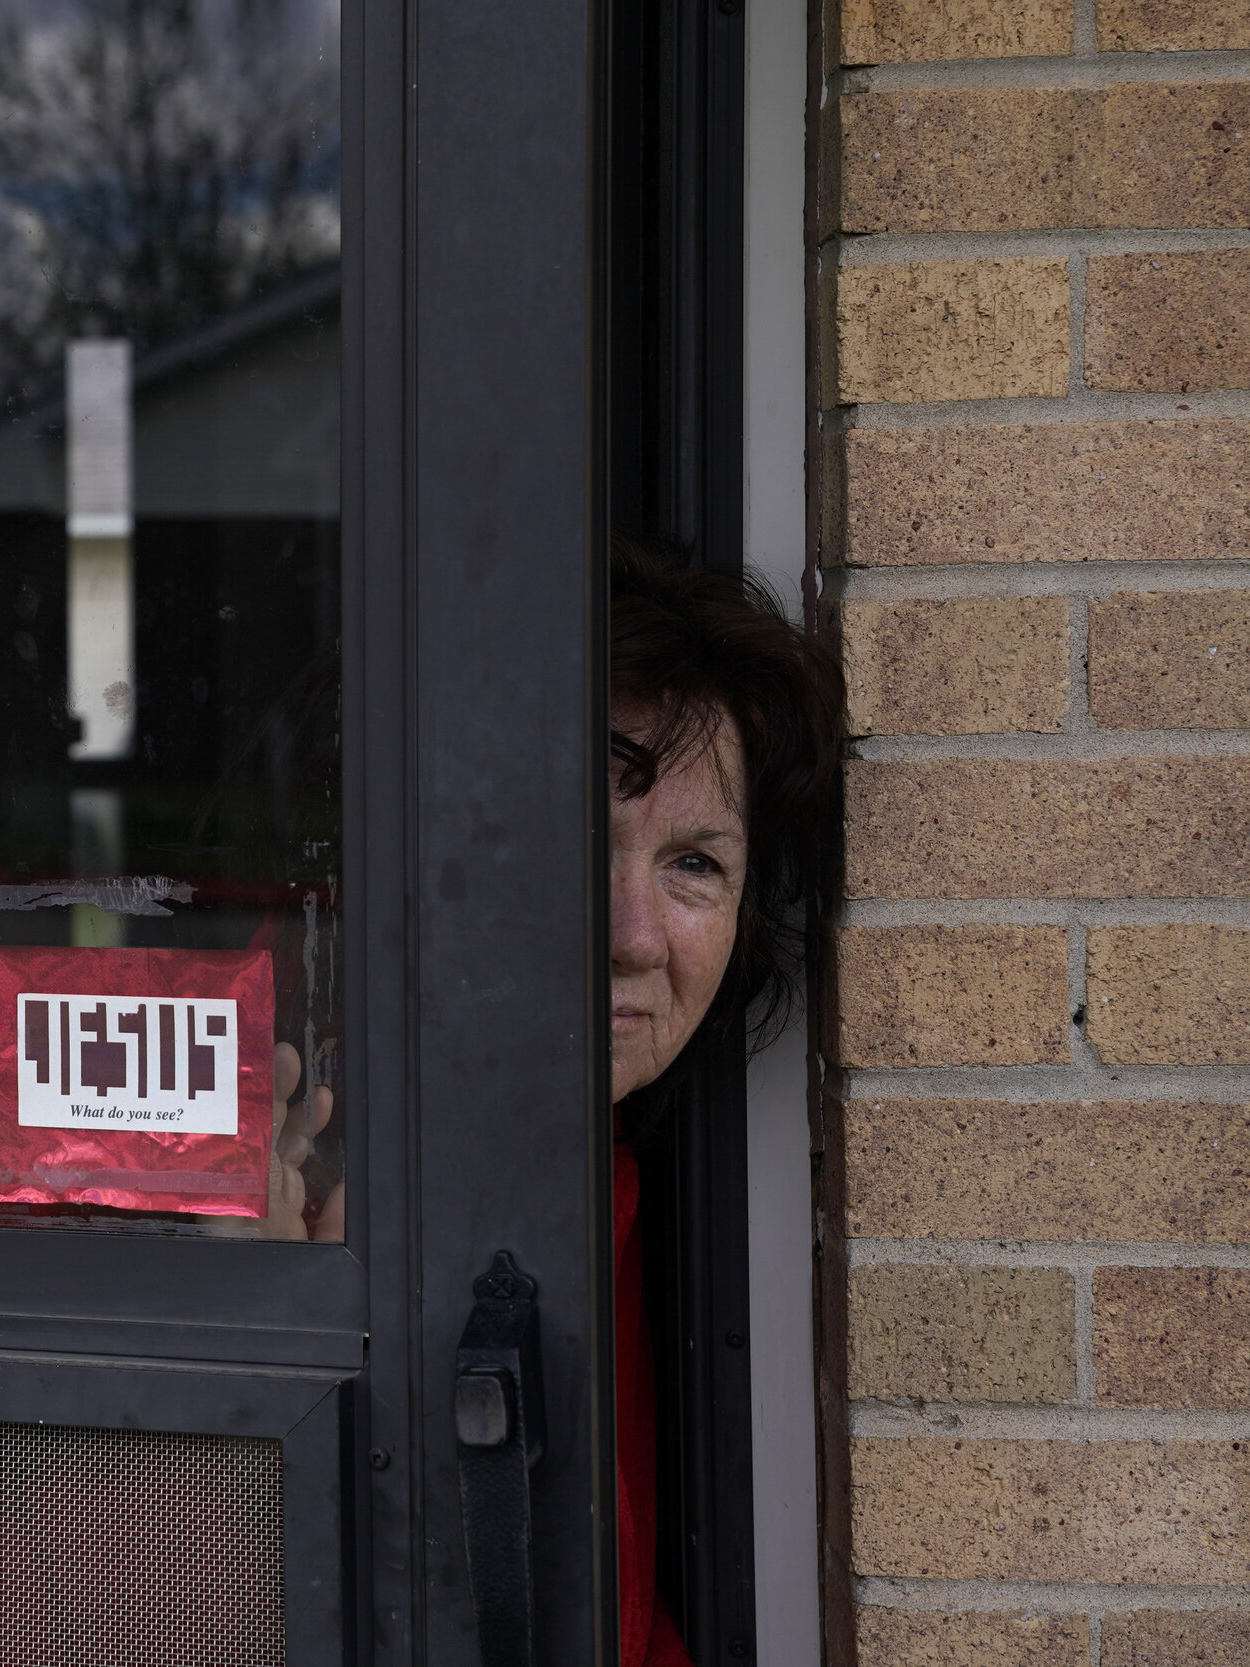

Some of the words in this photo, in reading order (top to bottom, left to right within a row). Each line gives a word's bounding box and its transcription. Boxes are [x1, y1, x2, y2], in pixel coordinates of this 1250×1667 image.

[24, 1000, 227, 1100] JESUS
[70, 1104, 105, 1118] What
[108, 1106, 124, 1119] do
[127, 1111, 152, 1122] you
[155, 1108, 184, 1121] see?
